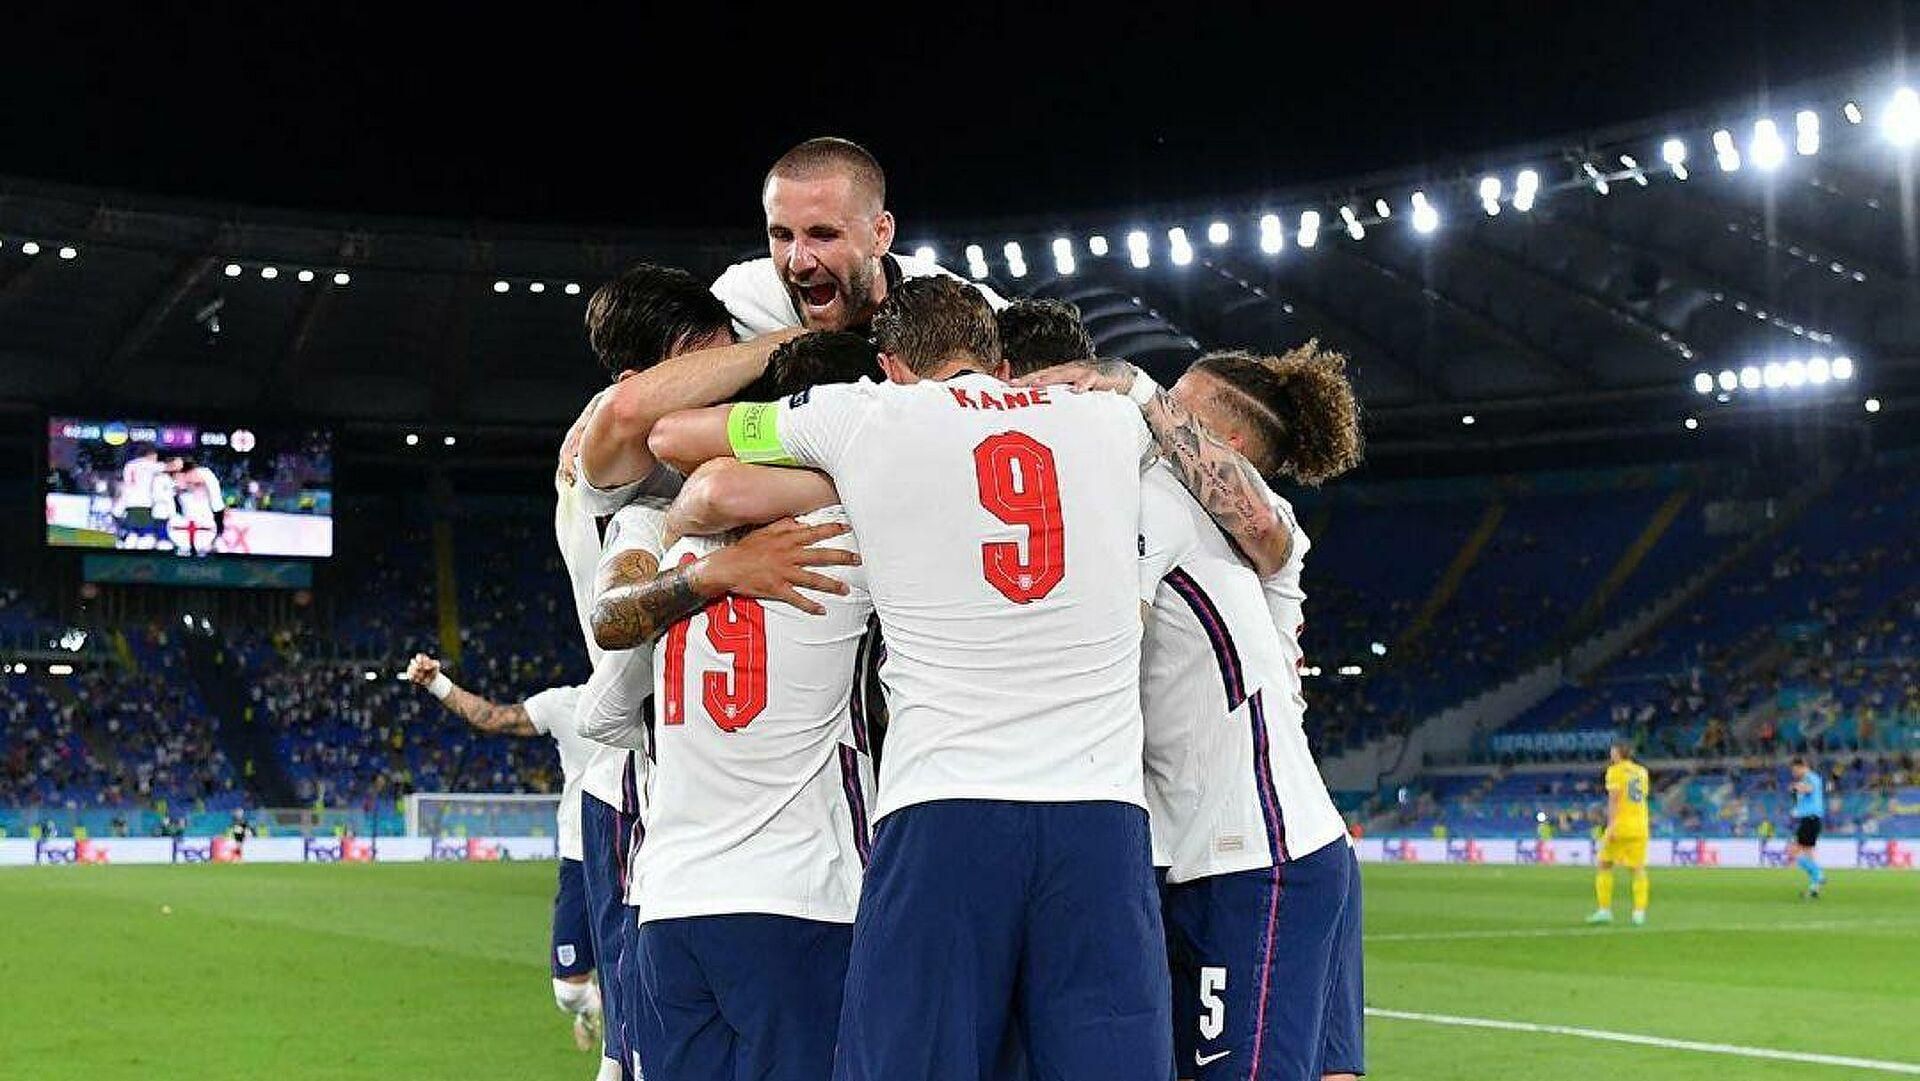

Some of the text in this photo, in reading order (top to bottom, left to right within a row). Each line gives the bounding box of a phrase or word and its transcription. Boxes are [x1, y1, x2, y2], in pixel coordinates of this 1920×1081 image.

[949, 386, 1051, 411] KANE
[973, 430, 1066, 604] 9
[664, 552, 768, 732] 19
[1200, 966, 1226, 1040] 5
